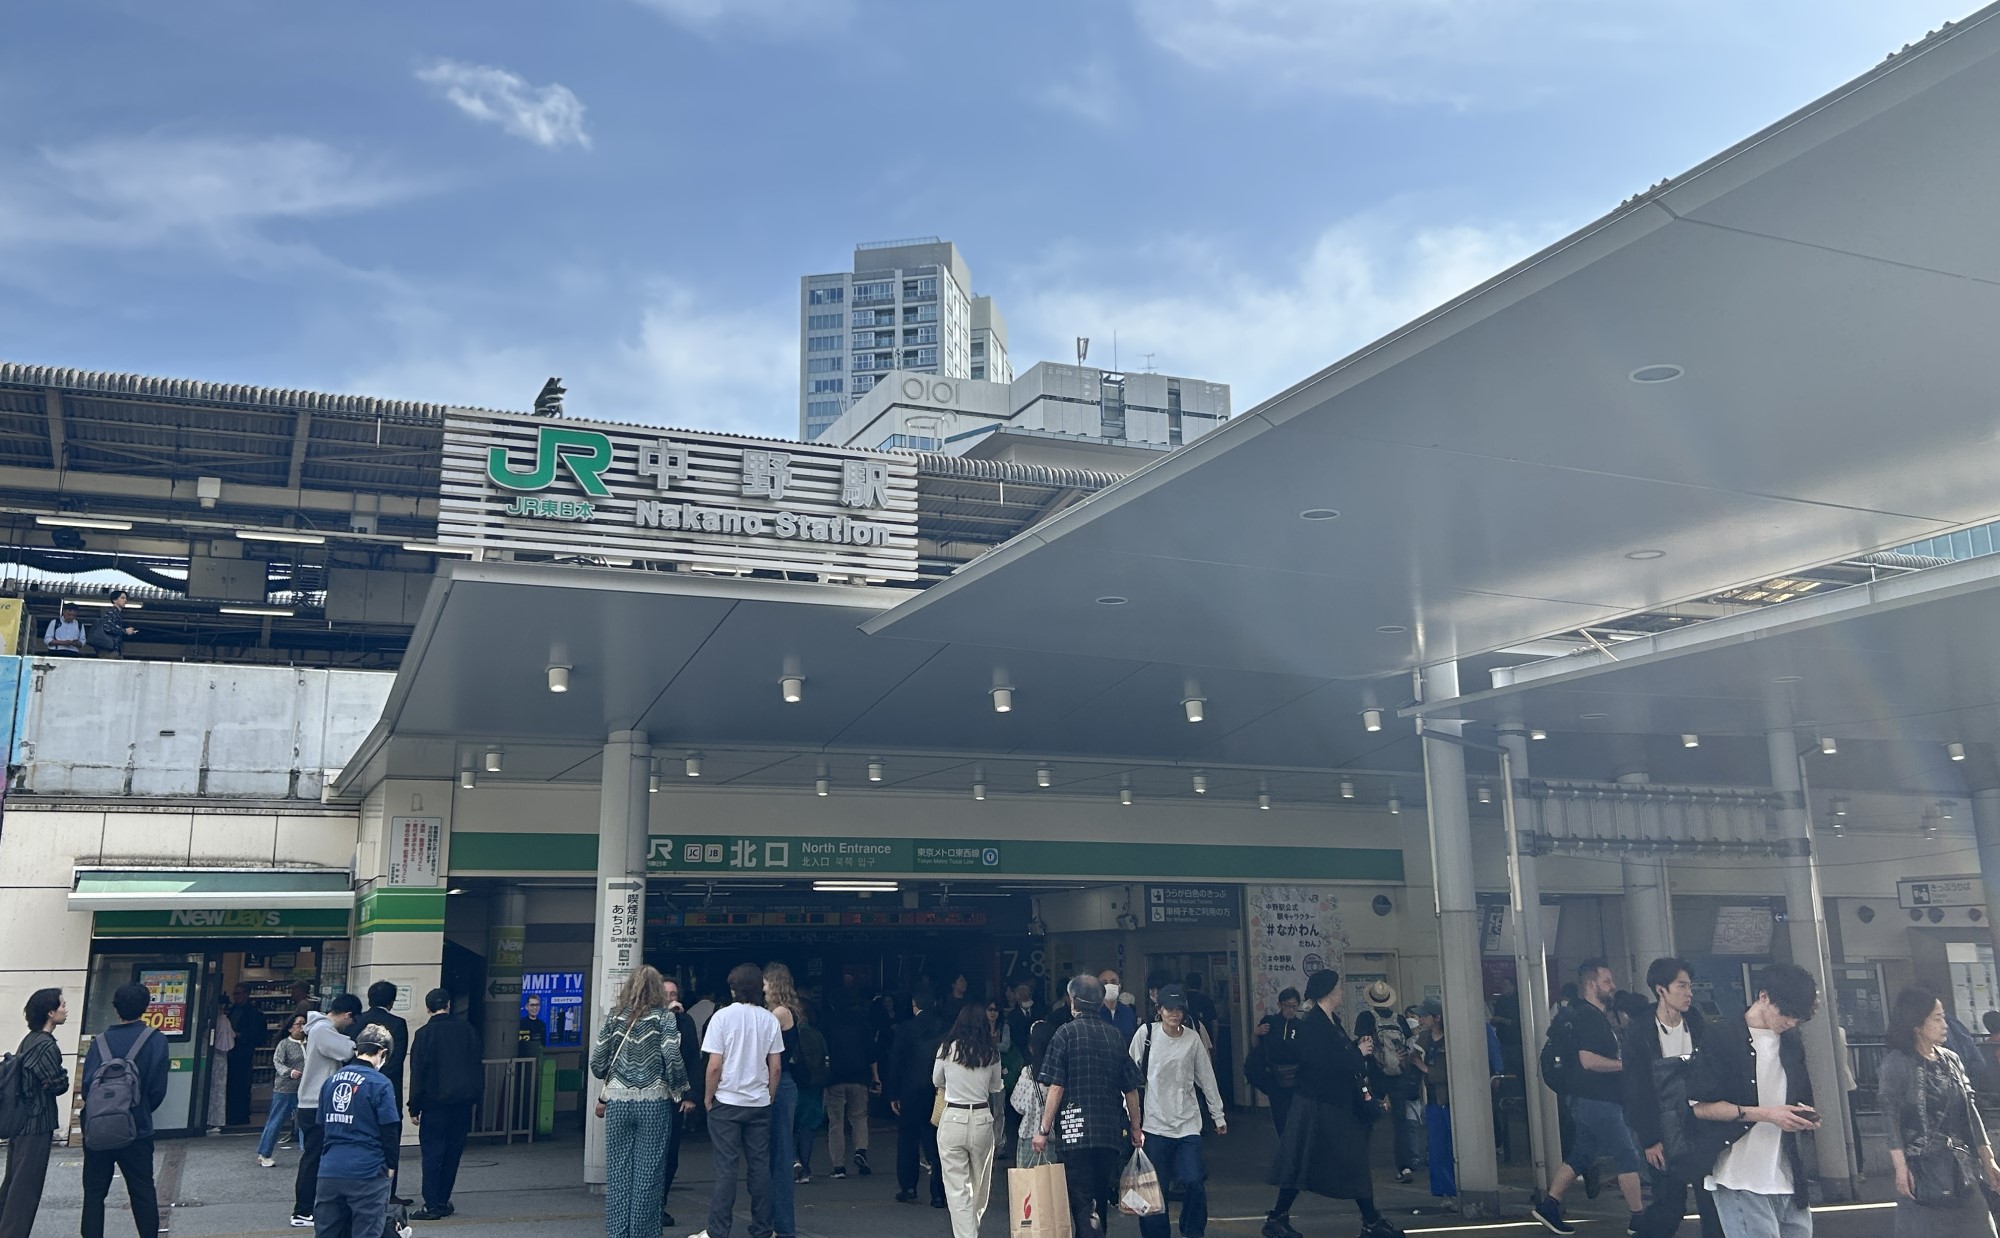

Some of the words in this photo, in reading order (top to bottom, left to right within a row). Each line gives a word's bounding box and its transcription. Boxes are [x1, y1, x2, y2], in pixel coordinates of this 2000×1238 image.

[487, 426, 614, 497] JR
[637, 439, 889, 509] 中野駅
[505, 497, 595, 520] JR東日本
[636, 500, 764, 536] Nakano
[775, 512, 890, 547] Station
[688, 849, 699, 857] JC
[708, 849, 719, 857] JB
[730, 840, 789, 868] 北口
[802, 842, 836, 854] North
[839, 843, 892, 854] Entrance
[917, 847, 980, 858] 東京メトロ東西線
[801, 856, 830, 867] 北入口
[1166, 889, 1227, 898] うらが白色のきっぷ
[626, 894, 639, 936] 喫煙所は
[1266, 904, 1298, 912] 中野駅公式
[612, 904, 624, 936] あちら
[1267, 924, 1320, 937] #なかわん
[564, 974, 583, 989] TV
[331, 1071, 366, 1085] FIGHTING
[325, 1113, 354, 1124] LAUNDRY
